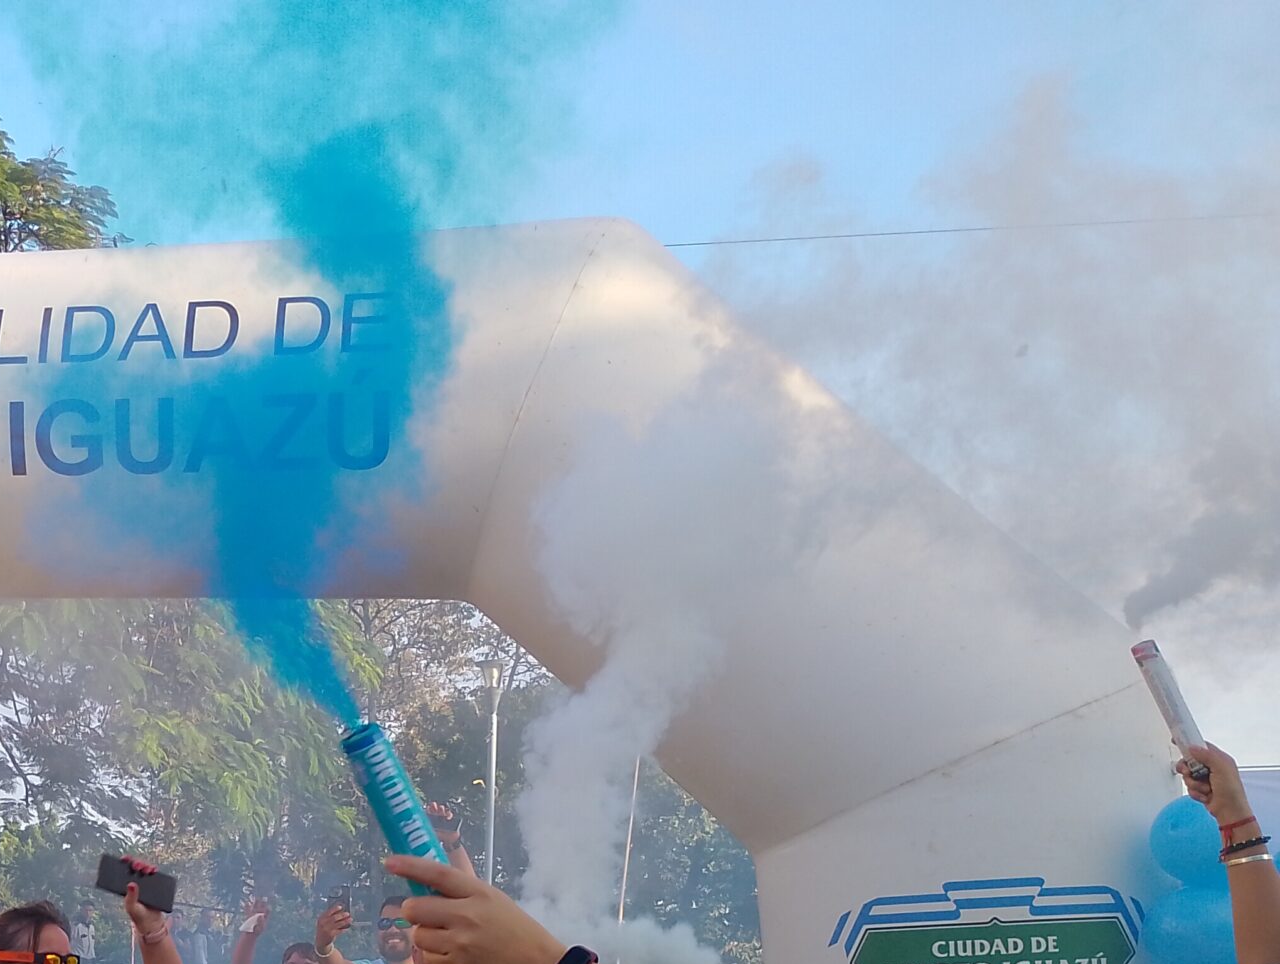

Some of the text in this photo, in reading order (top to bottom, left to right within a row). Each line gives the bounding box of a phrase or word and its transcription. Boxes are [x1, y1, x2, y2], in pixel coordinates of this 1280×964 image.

[273, 291, 394, 357] DE
[8, 369, 390, 477] IGUAZÚ
[931, 935, 1060, 958] CIUDAD DE
